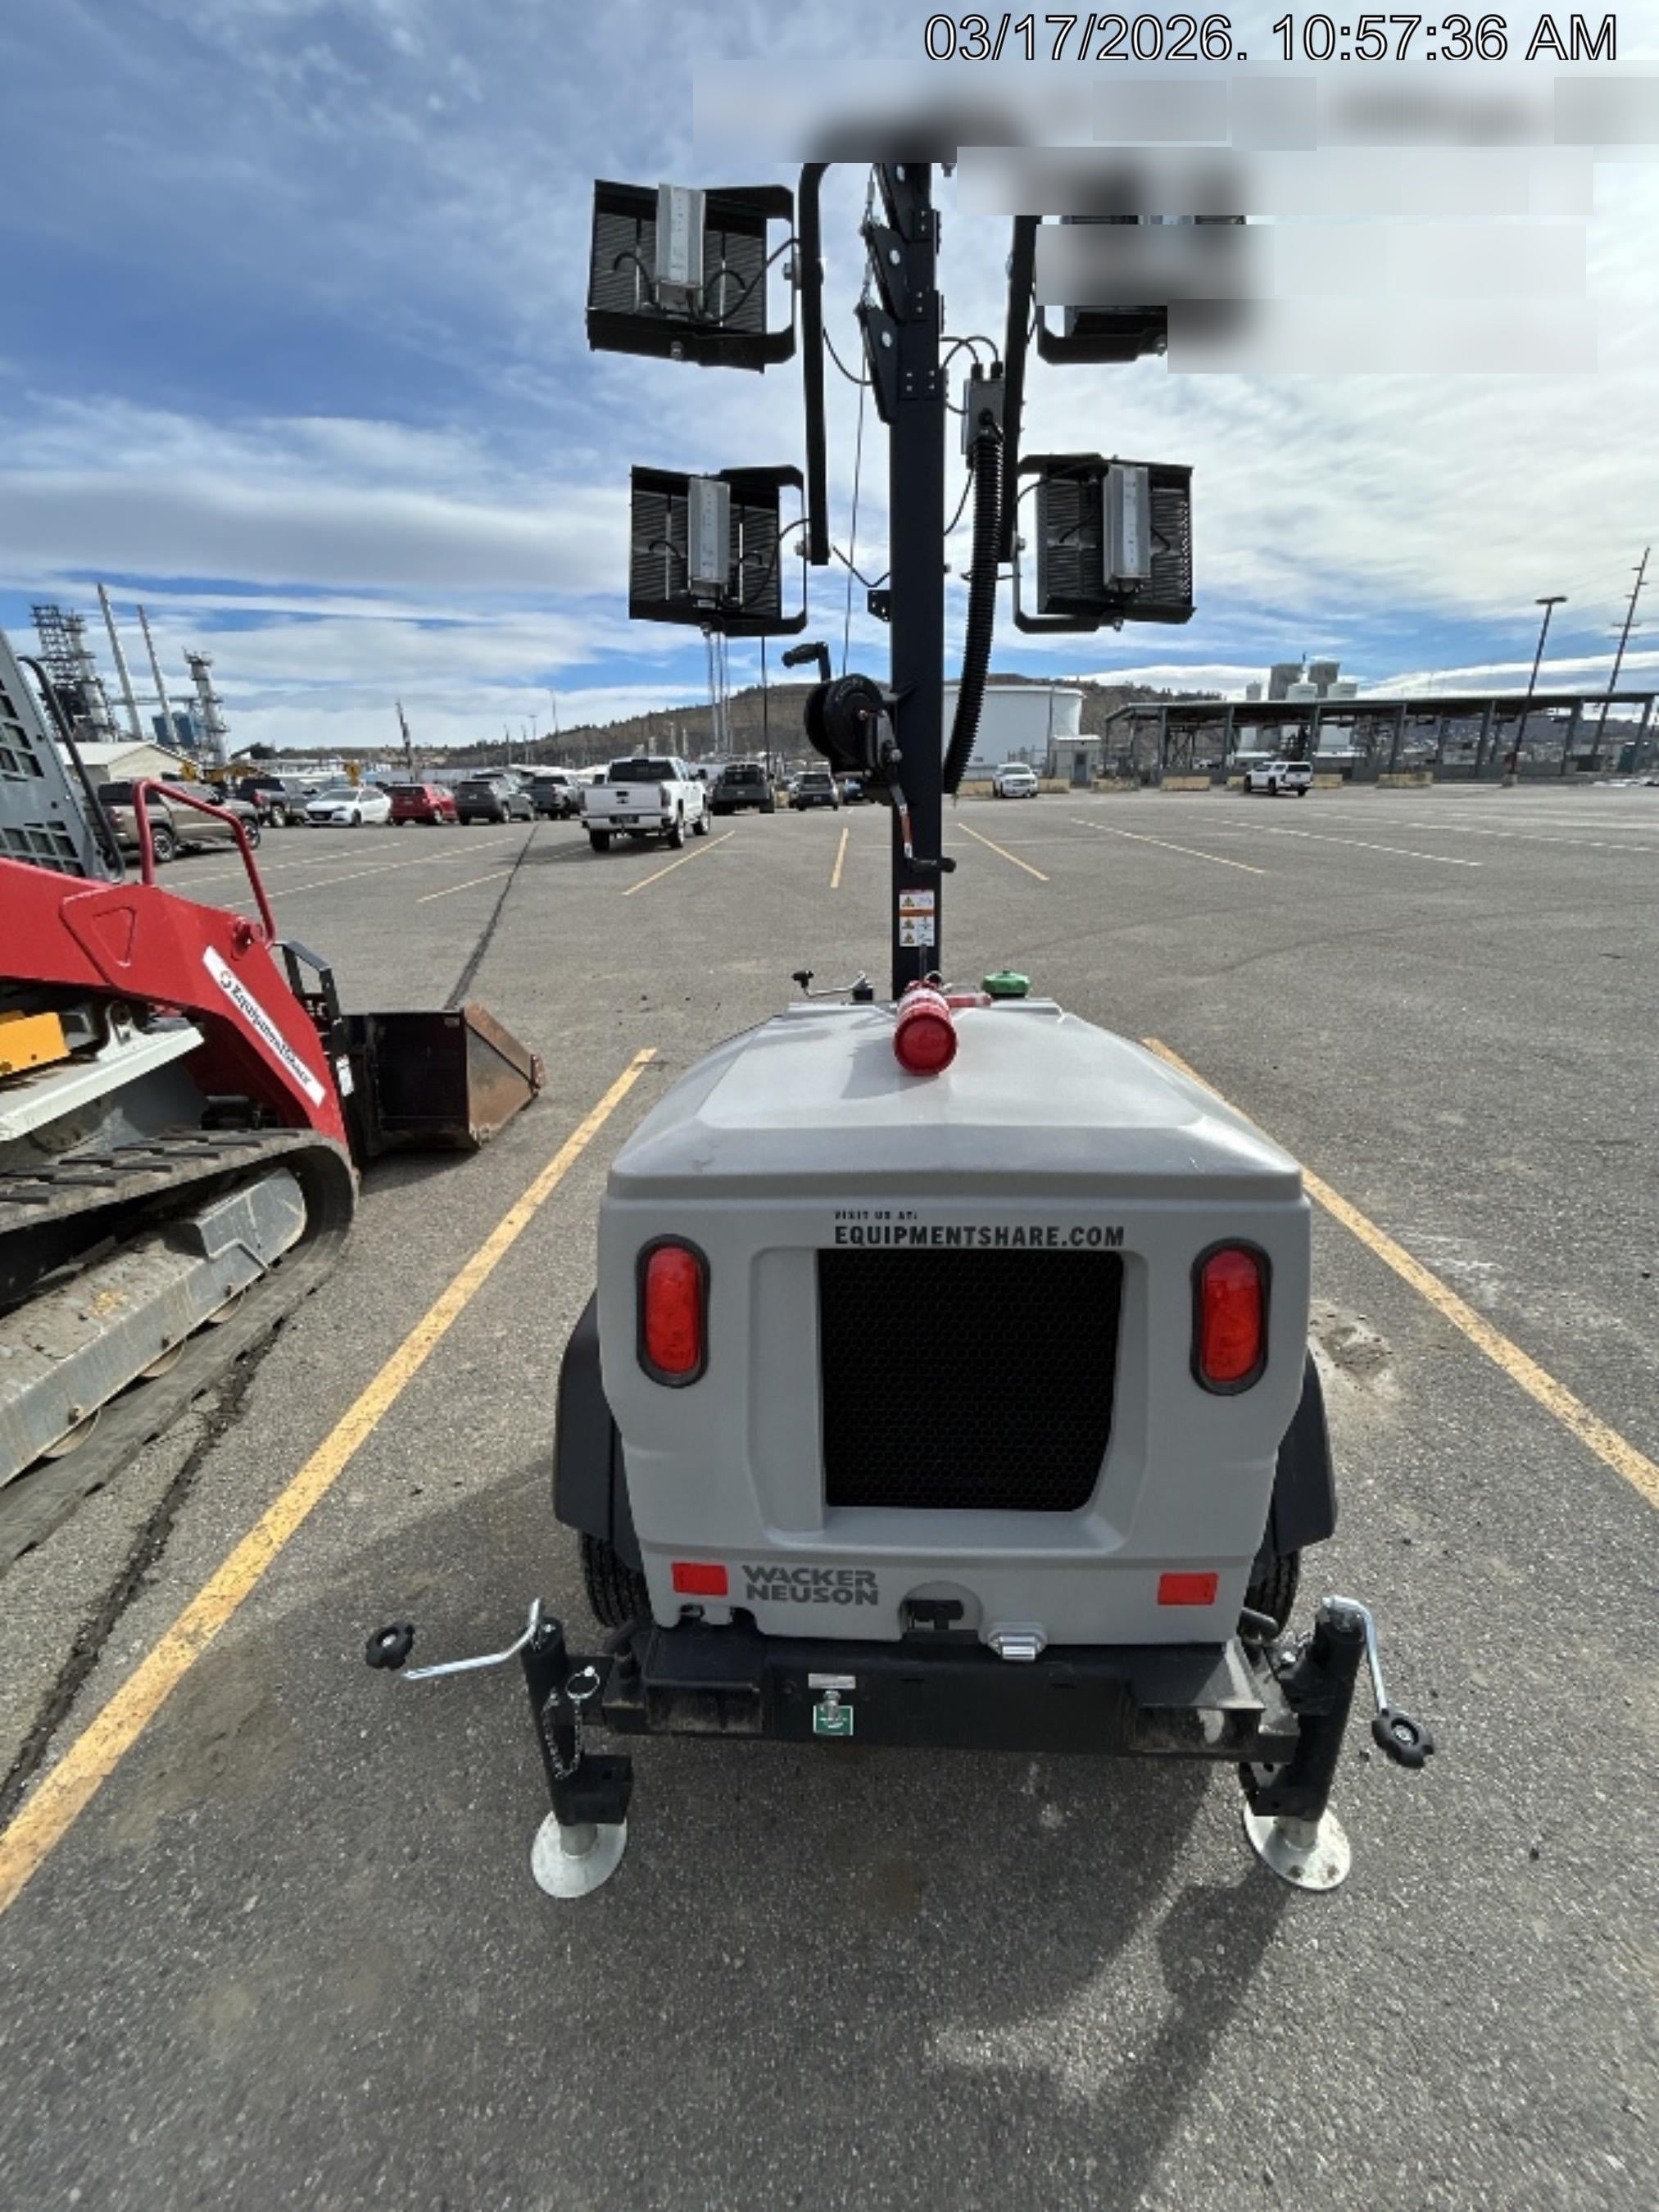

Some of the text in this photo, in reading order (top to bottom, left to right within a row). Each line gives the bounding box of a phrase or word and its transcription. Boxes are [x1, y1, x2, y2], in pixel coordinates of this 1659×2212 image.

[834, 1226, 1126, 1247] EQUIPMENTSHARE.COM
[741, 1565, 878, 1588] WACKER
[746, 1584, 879, 1606] NEUSON
